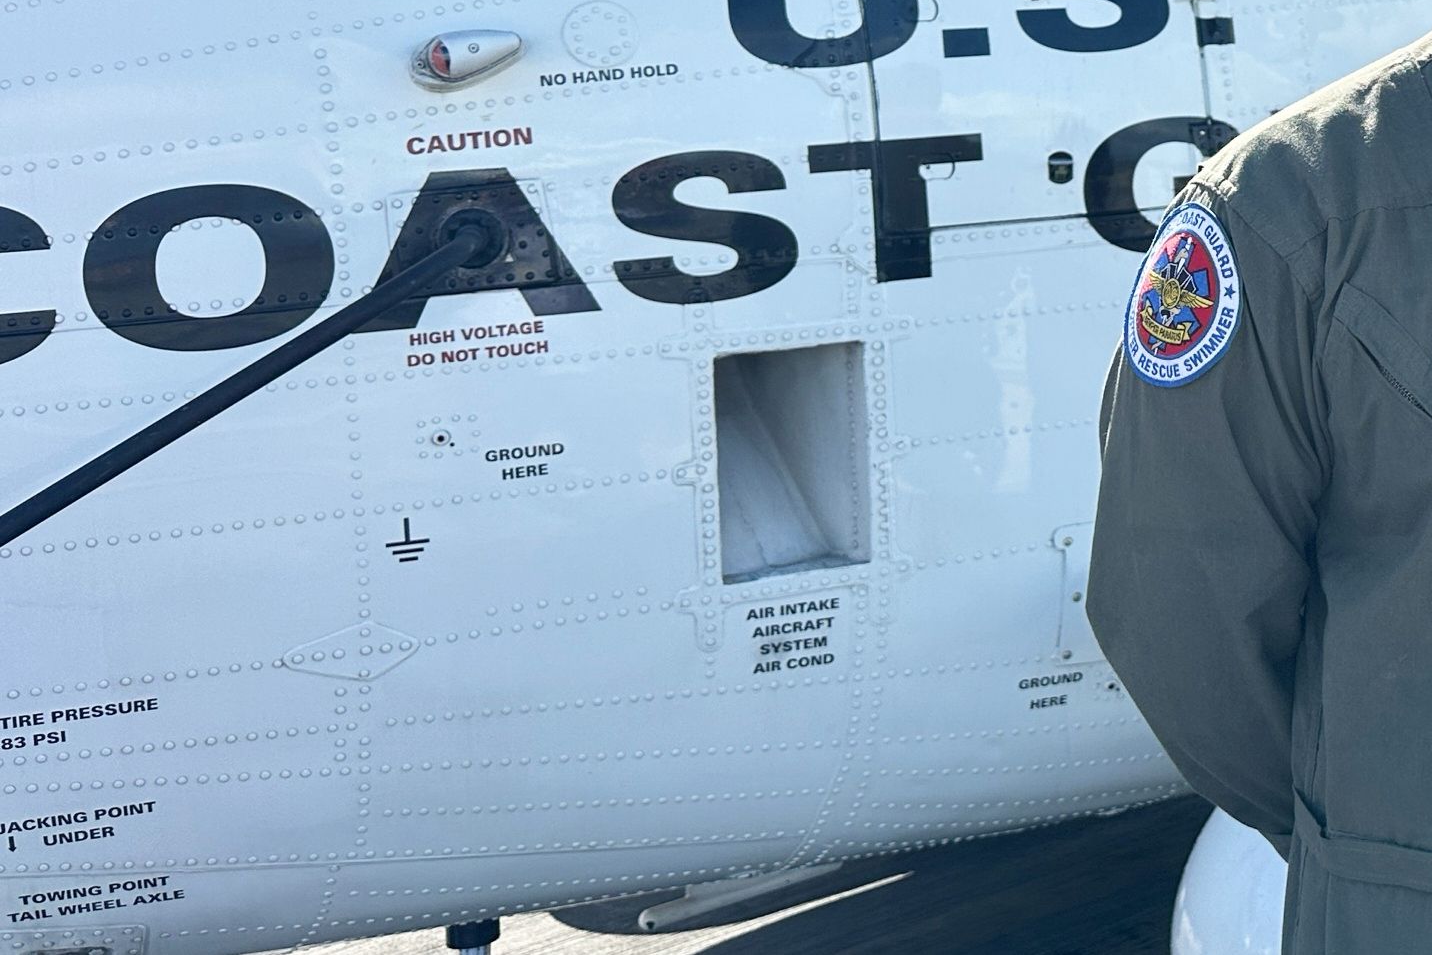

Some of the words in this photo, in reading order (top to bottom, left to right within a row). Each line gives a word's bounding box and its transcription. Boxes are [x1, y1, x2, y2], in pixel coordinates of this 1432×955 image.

[540, 73, 567, 87] NO
[573, 68, 625, 84] HAND
[630, 63, 679, 78] HOLD
[406, 126, 533, 156] CAUTION
[0, 132, 982, 363] OAST
[1179, 211, 1206, 230] OAST
[1204, 225, 1234, 279] GUARD
[409, 329, 455, 346] HIGH
[460, 320, 545, 341] VOLTAGE
[1137, 353, 1181, 379] RESCUE
[1183, 306, 1235, 372] SWIMMER
[407, 353, 435, 367] DO
[441, 348, 480, 364] NOT
[485, 340, 549, 359] TOUCH
[485, 443, 565, 463] GROUND
[501, 463, 549, 481] HERE
[746, 607, 775, 621] AIR
[780, 597, 841, 616] INTAKE
[752, 616, 836, 638] AIRCRAFT
[760, 636, 828, 655] SYSTEM
[753, 660, 781, 674] AIR
[786, 653, 835, 670] COND
[1018, 671, 1084, 690] GROUND
[0, 712, 45, 730] TIRE
[51, 698, 159, 723] PRESSURE
[1030, 694, 1068, 710] HERE
[0, 736, 26, 750] 83
[33, 730, 67, 746] PSI
[0, 811, 88, 835] JACKING
[94, 801, 156, 821] POINT
[43, 826, 115, 847] UNDER
[19, 885, 103, 906] TOWING
[109, 875, 170, 894] POINT
[7, 908, 53, 923] TAIL
[58, 898, 128, 916] WHEEL
[132, 889, 185, 906] AXLE
